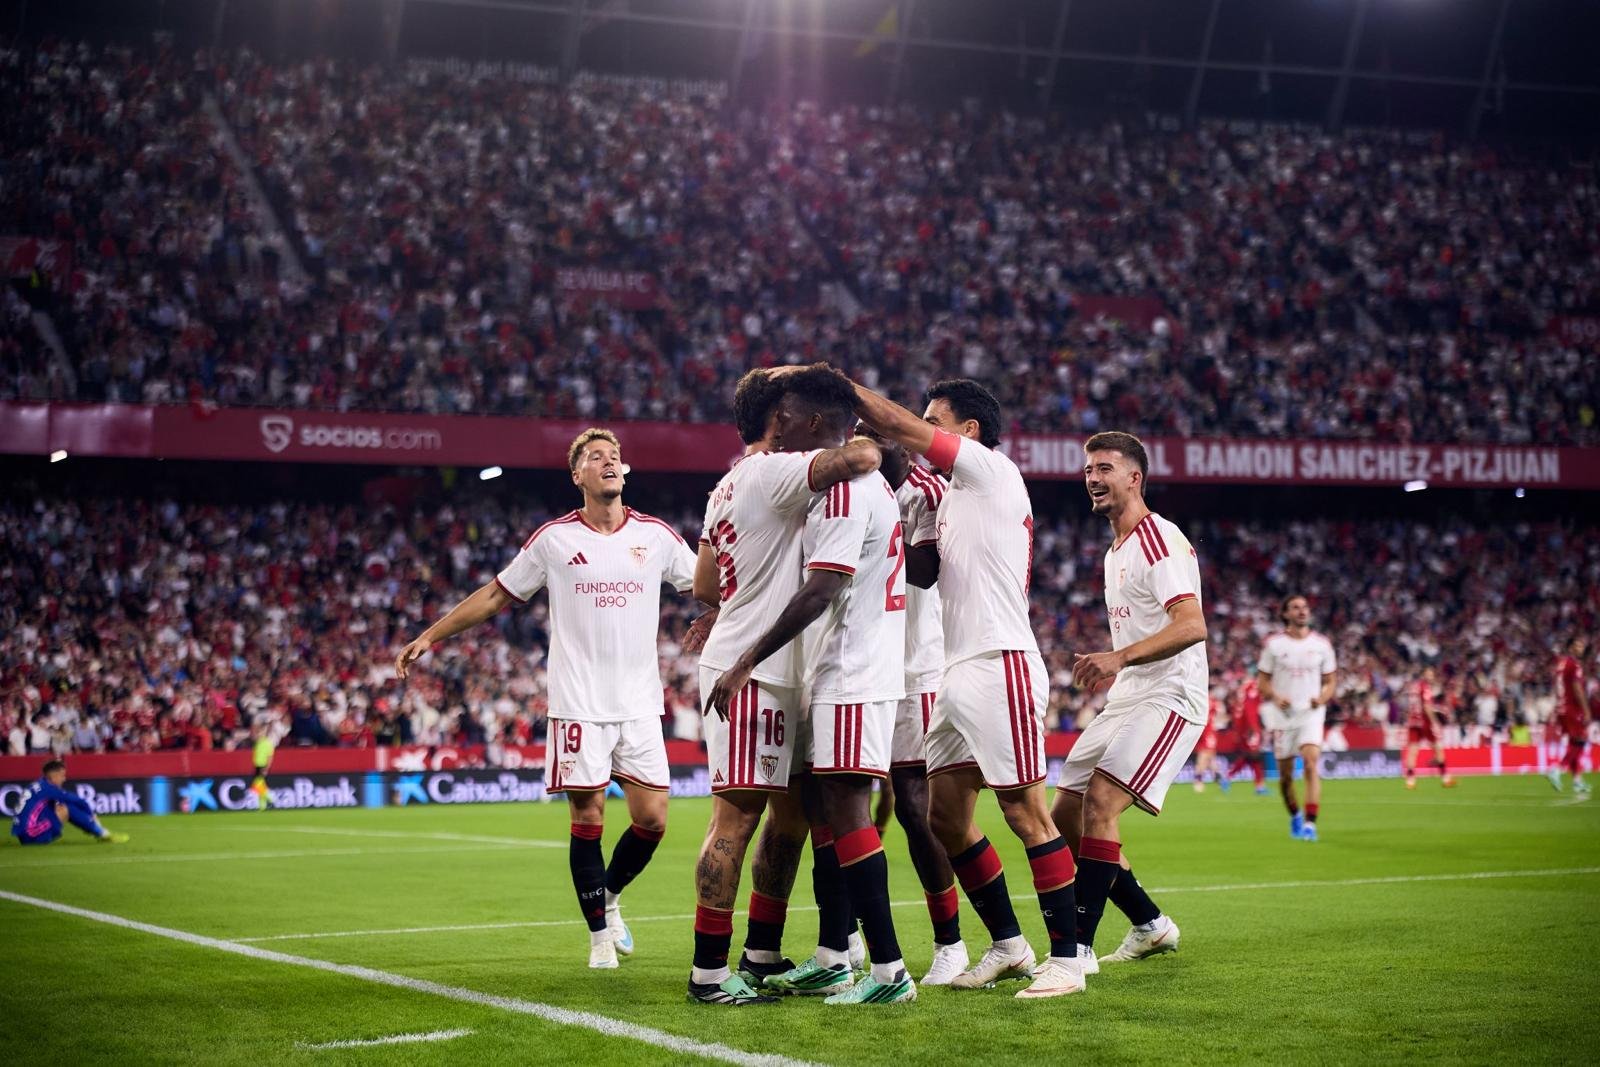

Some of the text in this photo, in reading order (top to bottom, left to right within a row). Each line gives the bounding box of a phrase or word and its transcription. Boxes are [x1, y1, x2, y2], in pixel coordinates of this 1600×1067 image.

[1185, 442, 1294, 479] RAMON
[1300, 445, 1560, 482] SANCHEZ-PIZJUAN
[575, 580, 643, 594] FUNDACIÓN
[595, 595, 627, 608] 1890
[561, 722, 582, 754] 19
[761, 707, 785, 748] 16
